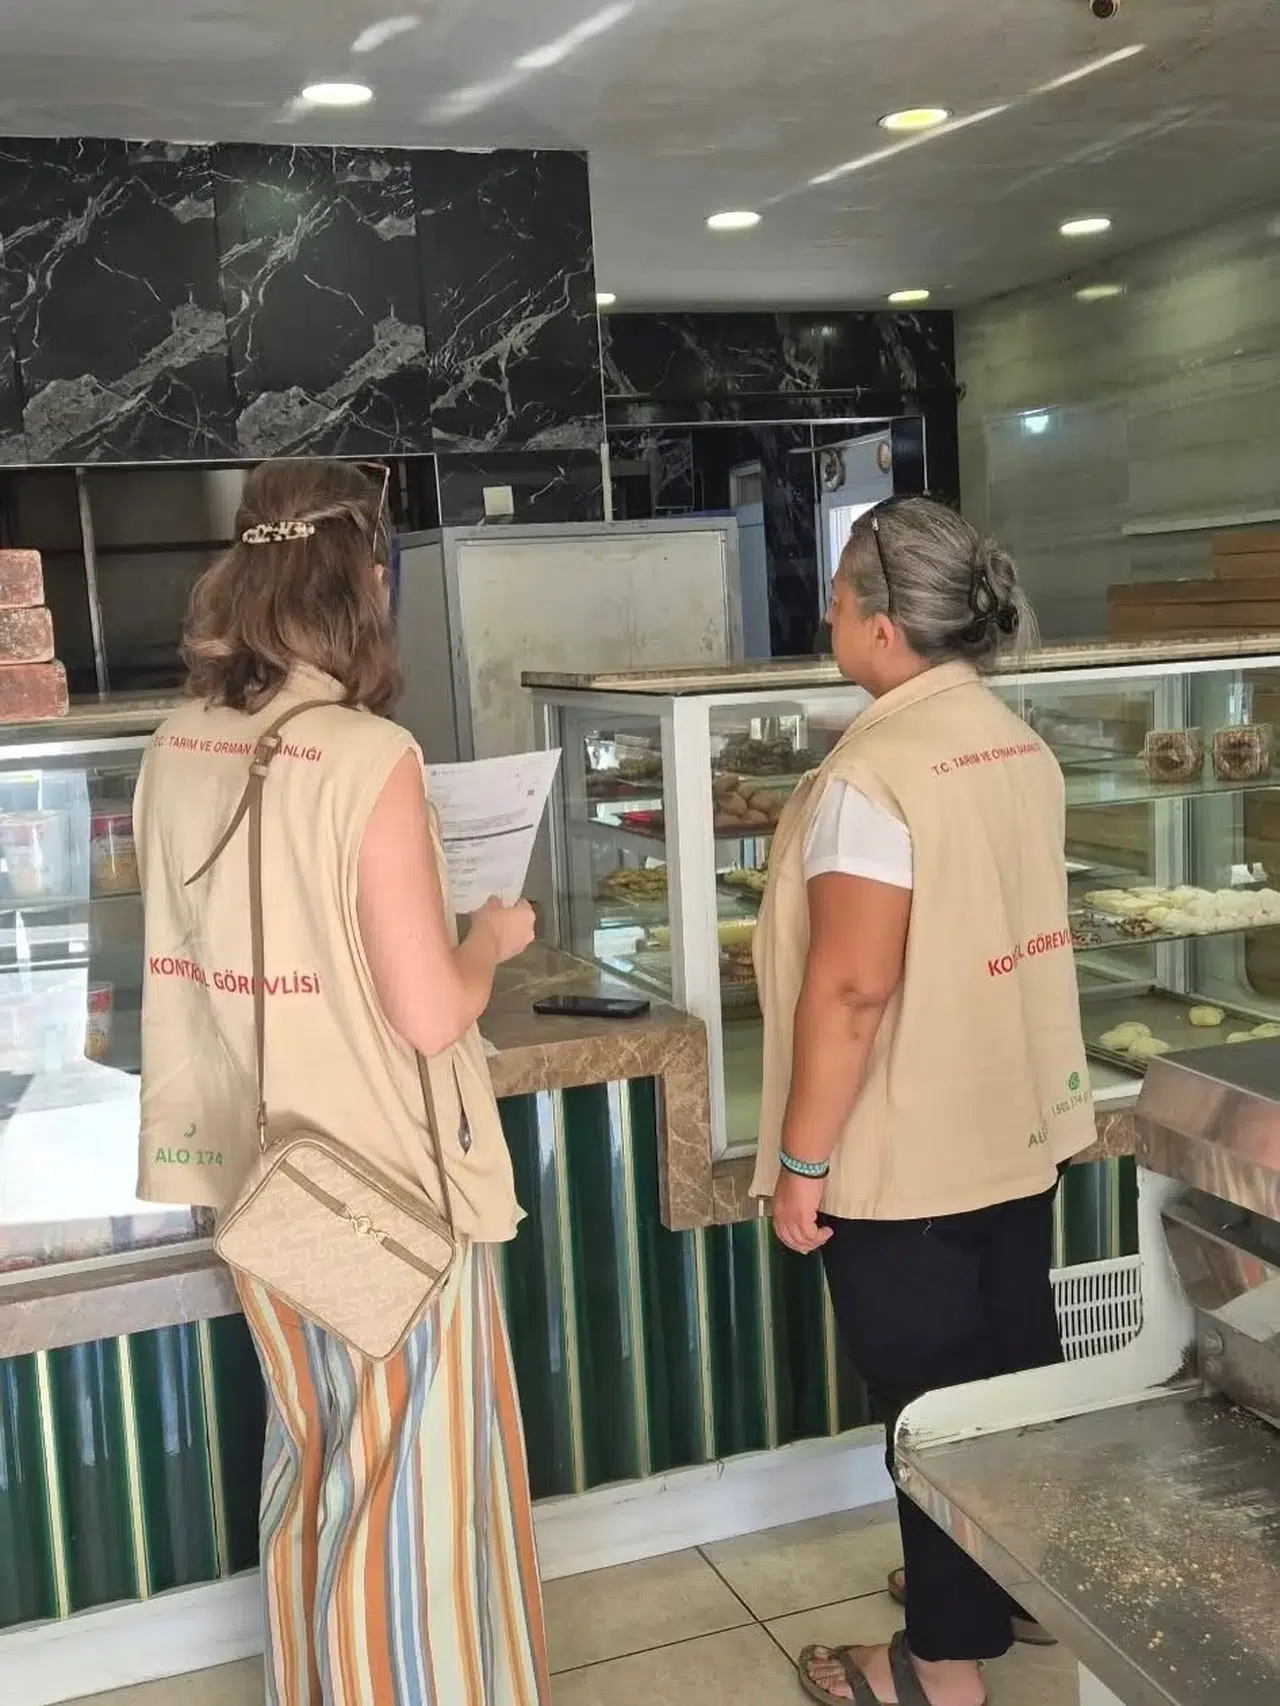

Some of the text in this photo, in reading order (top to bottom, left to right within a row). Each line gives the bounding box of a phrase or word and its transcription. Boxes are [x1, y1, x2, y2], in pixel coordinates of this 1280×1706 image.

[168, 736, 197, 751] TARIM
[200, 739, 212, 752] VE
[213, 740, 251, 756] ORMAN
[254, 744, 322, 762] ANLIĞI
[155, 1147, 224, 1166] ALO 174
